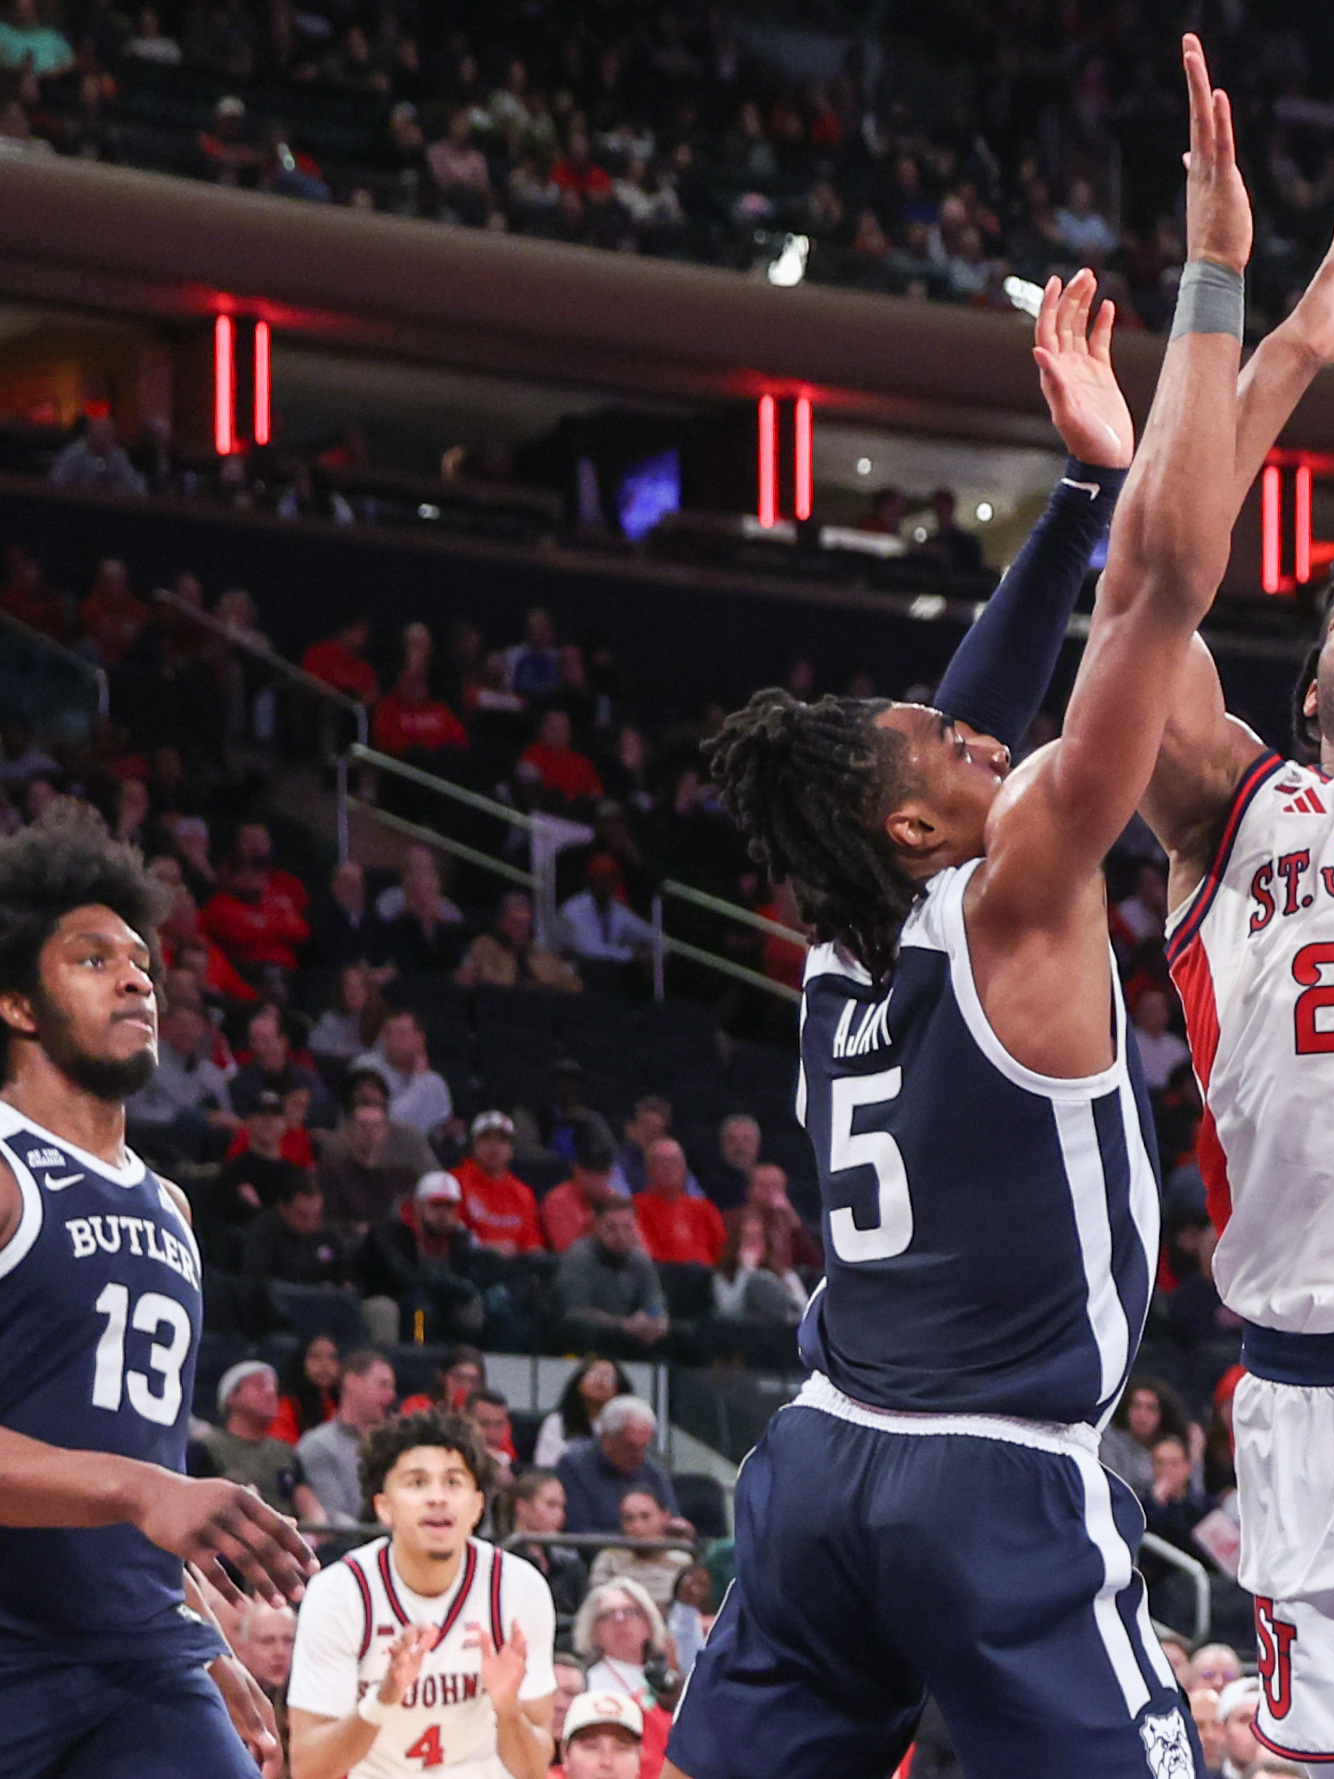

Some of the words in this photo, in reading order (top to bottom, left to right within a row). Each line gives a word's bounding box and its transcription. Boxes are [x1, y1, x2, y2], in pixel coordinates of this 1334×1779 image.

[1248, 848, 1314, 938] ST.
[829, 1065, 914, 1263] 5
[65, 1215, 200, 1292] BUTLER
[92, 1282, 191, 1426] 13
[401, 1672, 487, 1708] JOHN
[405, 1723, 444, 1768] 4
